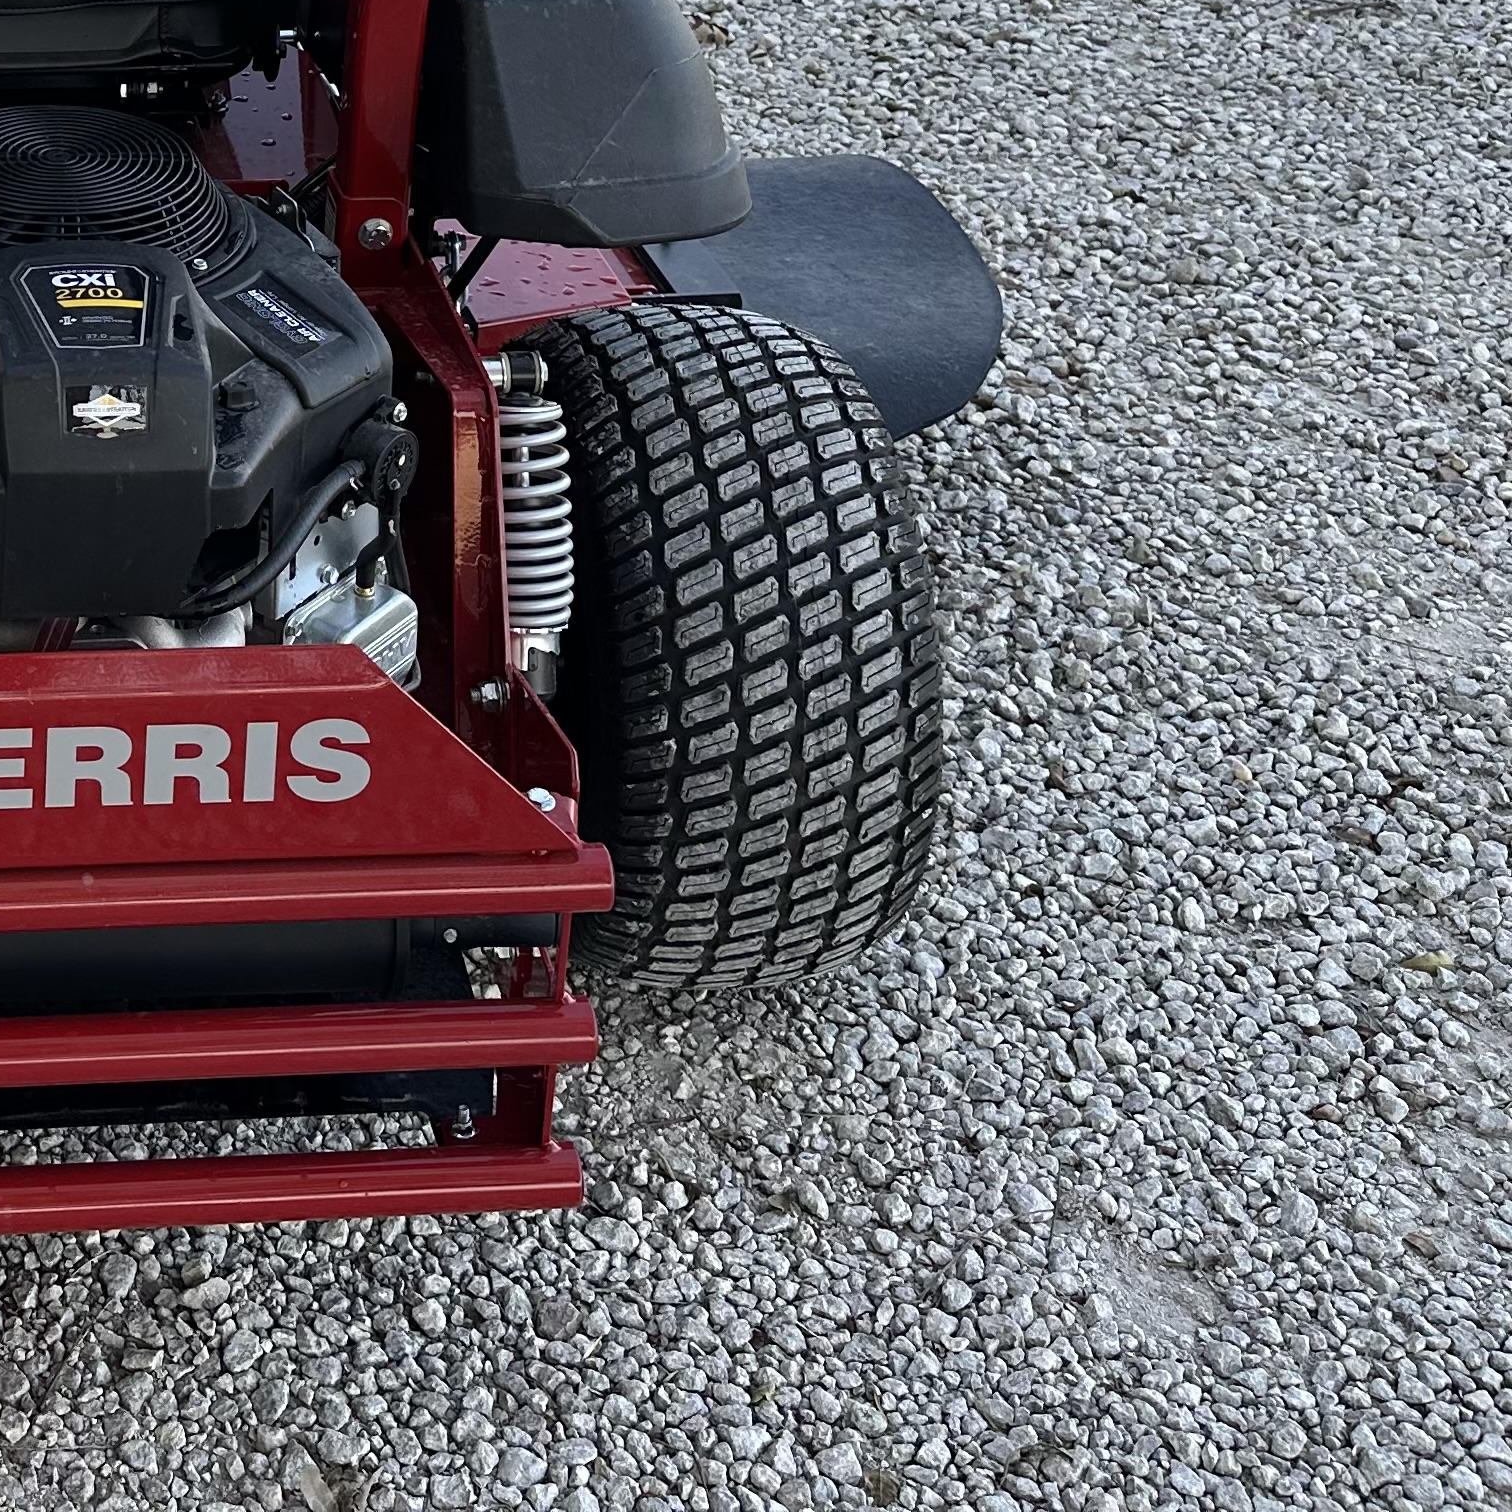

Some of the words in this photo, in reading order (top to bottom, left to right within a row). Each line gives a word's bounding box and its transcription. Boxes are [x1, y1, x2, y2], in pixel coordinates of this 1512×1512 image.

[55, 288, 123, 300] 2700
[248, 289, 299, 327] CLEANER
[296, 327, 322, 341] AIR
